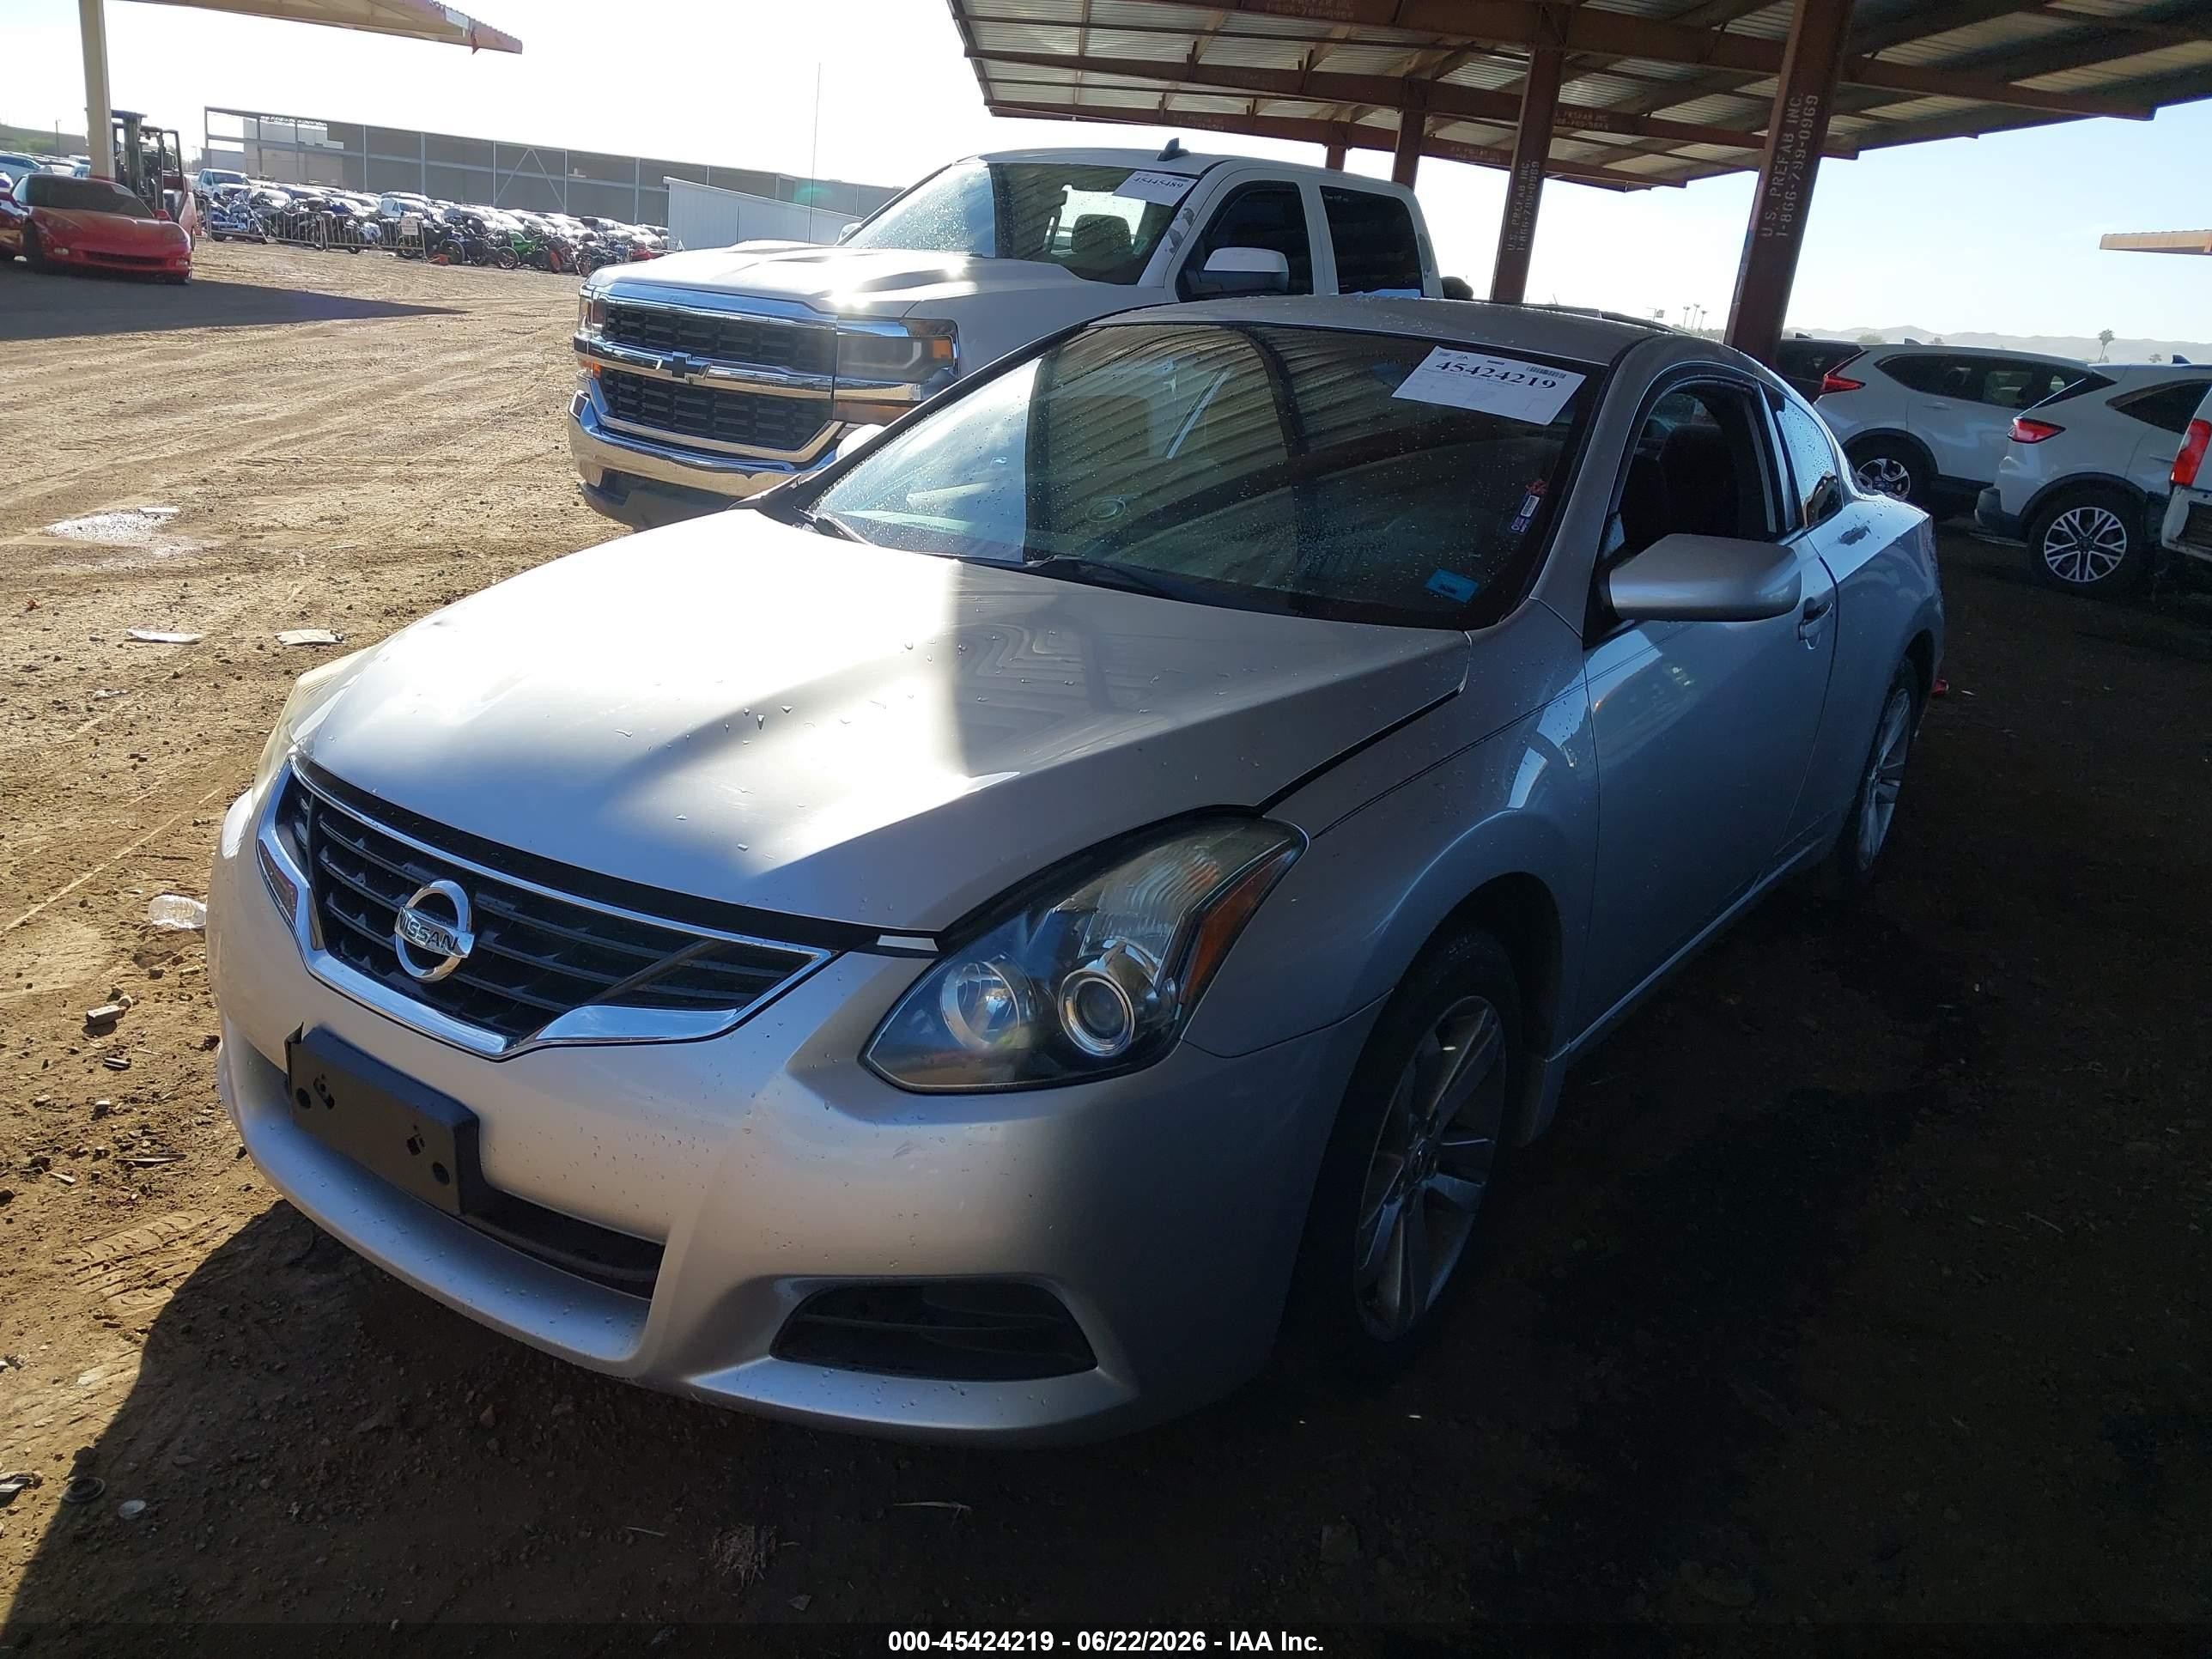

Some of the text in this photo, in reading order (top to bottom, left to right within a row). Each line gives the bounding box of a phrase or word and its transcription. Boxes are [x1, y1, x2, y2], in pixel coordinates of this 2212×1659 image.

[1770, 133, 1794, 197] PREFAB
[1435, 361, 1557, 389] 45424219
[398, 910, 459, 951] NISSAN
